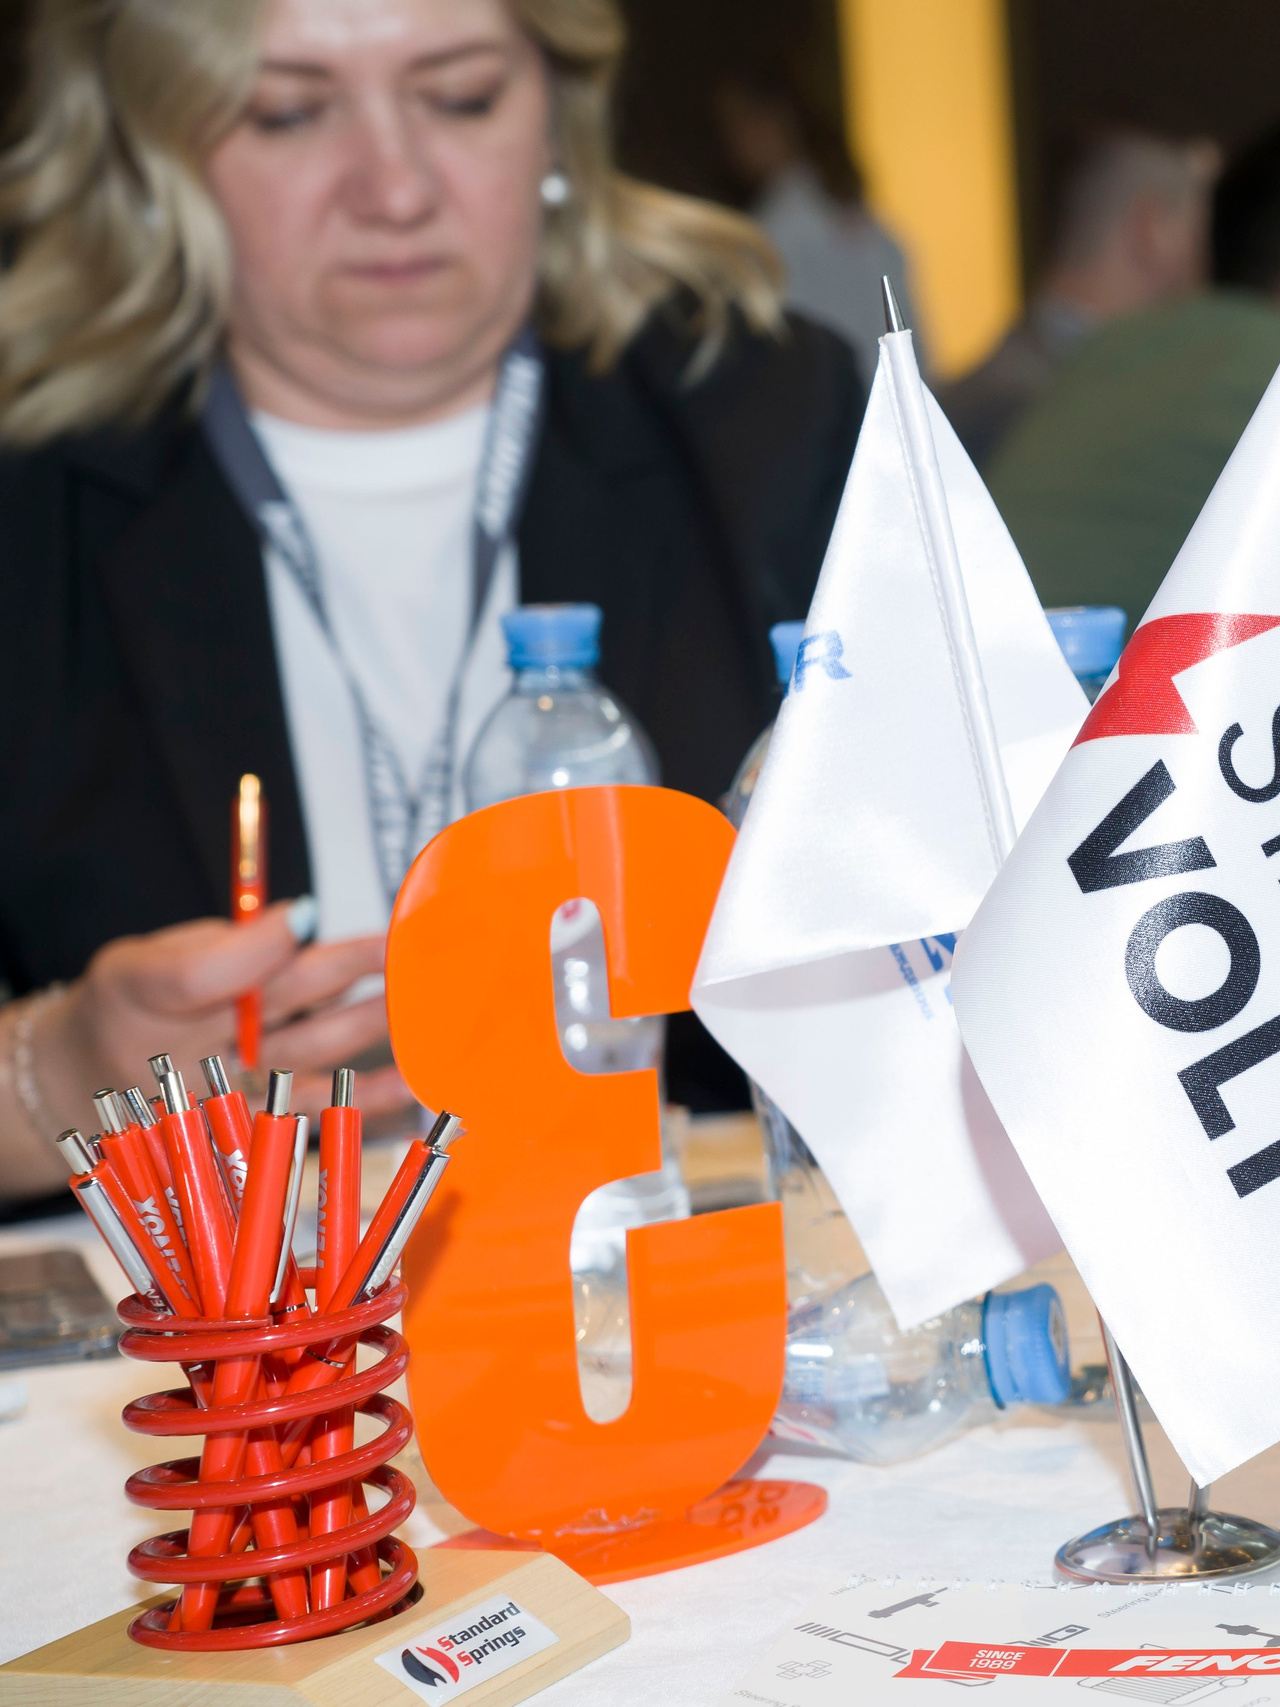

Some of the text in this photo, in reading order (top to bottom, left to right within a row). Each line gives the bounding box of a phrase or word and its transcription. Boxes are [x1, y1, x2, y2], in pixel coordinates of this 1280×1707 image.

[437, 1602, 521, 1652] Standard
[457, 1626, 526, 1667] Springs
[975, 1649, 1026, 1661] SINCE
[969, 1658, 1016, 1670] 1989
